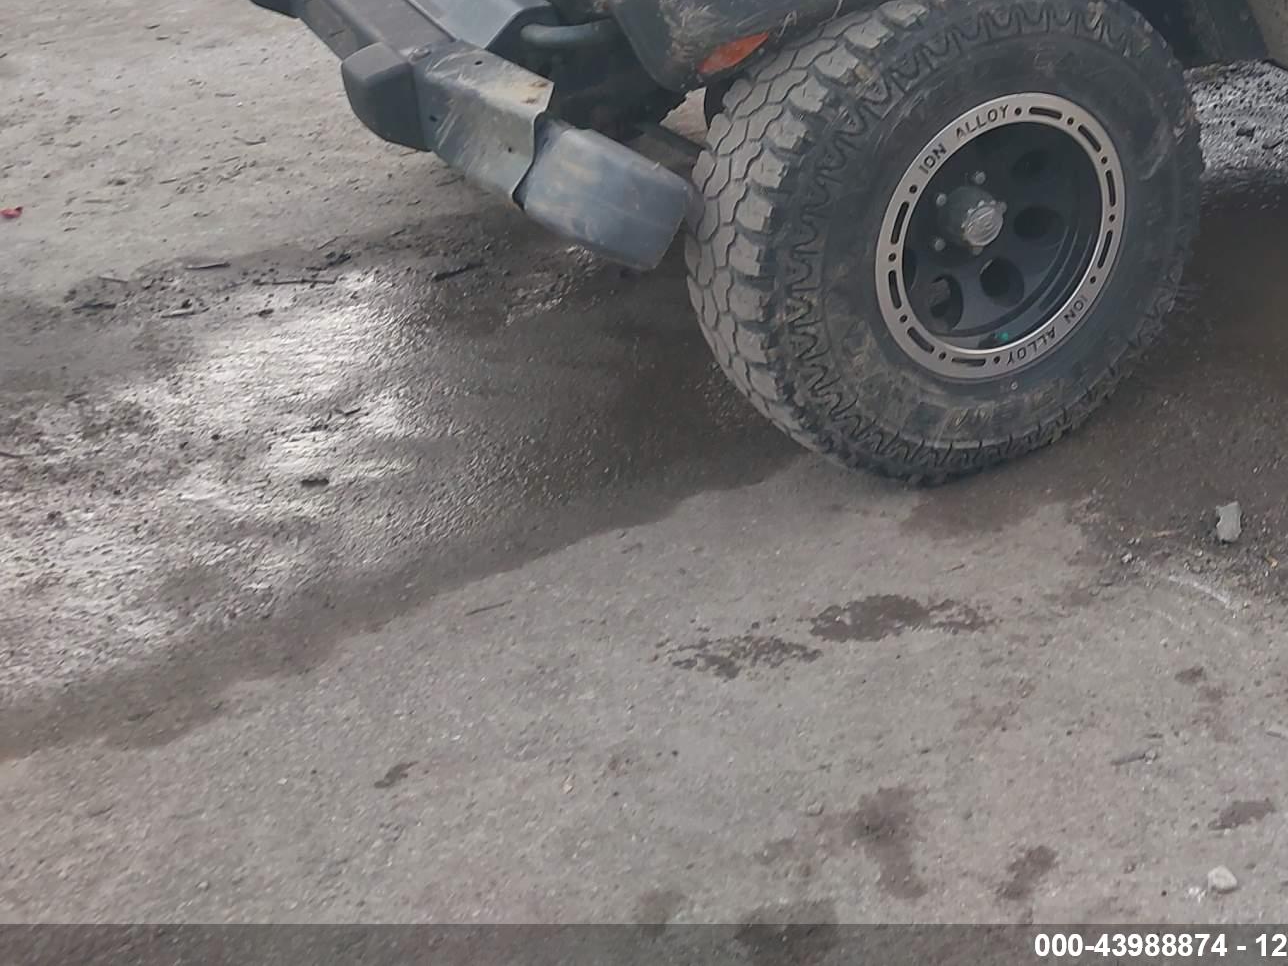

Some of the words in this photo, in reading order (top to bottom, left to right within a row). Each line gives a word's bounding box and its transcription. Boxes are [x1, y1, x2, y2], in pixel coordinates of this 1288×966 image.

[919, 143, 948, 174] ION
[956, 104, 1009, 139] ALLOY
[1063, 295, 1089, 324] ION
[1007, 326, 1056, 368] ALLOY
